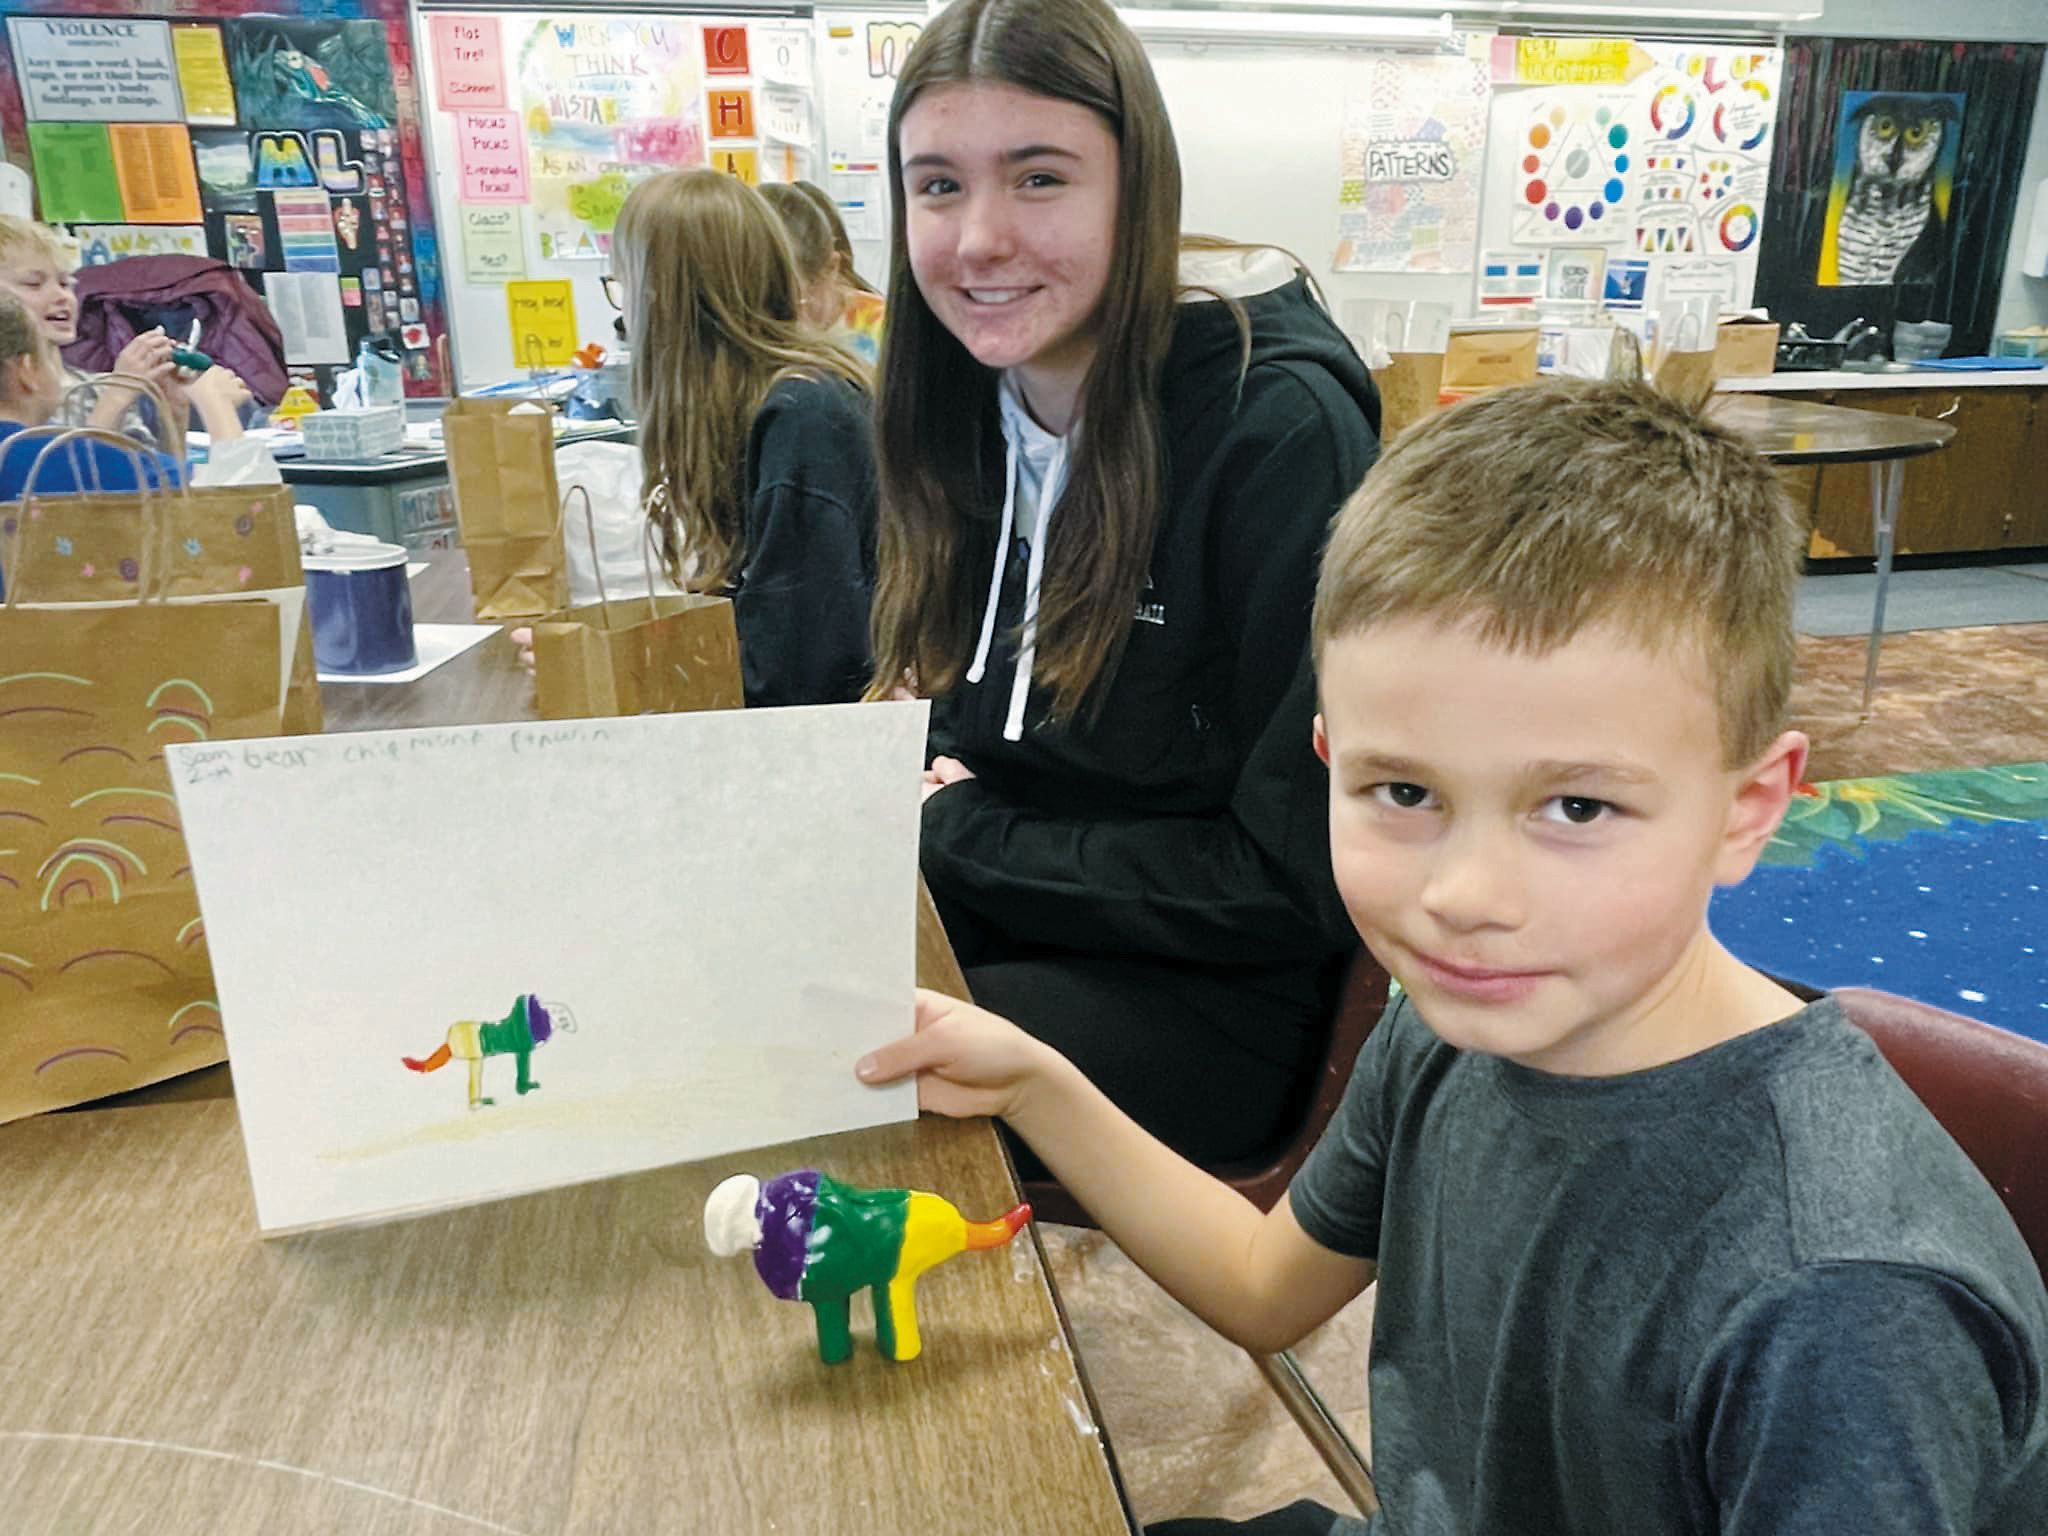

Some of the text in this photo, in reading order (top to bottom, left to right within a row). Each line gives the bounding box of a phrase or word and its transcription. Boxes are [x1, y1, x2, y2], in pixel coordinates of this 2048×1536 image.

[46, 22, 138, 37] VIOLENCE
[625, 21, 670, 53] YOU
[717, 28, 739, 64] C
[566, 53, 649, 75] THINK
[718, 95, 744, 127] H
[1370, 150, 1449, 177] PATTERNS
[243, 747, 319, 769] bear
